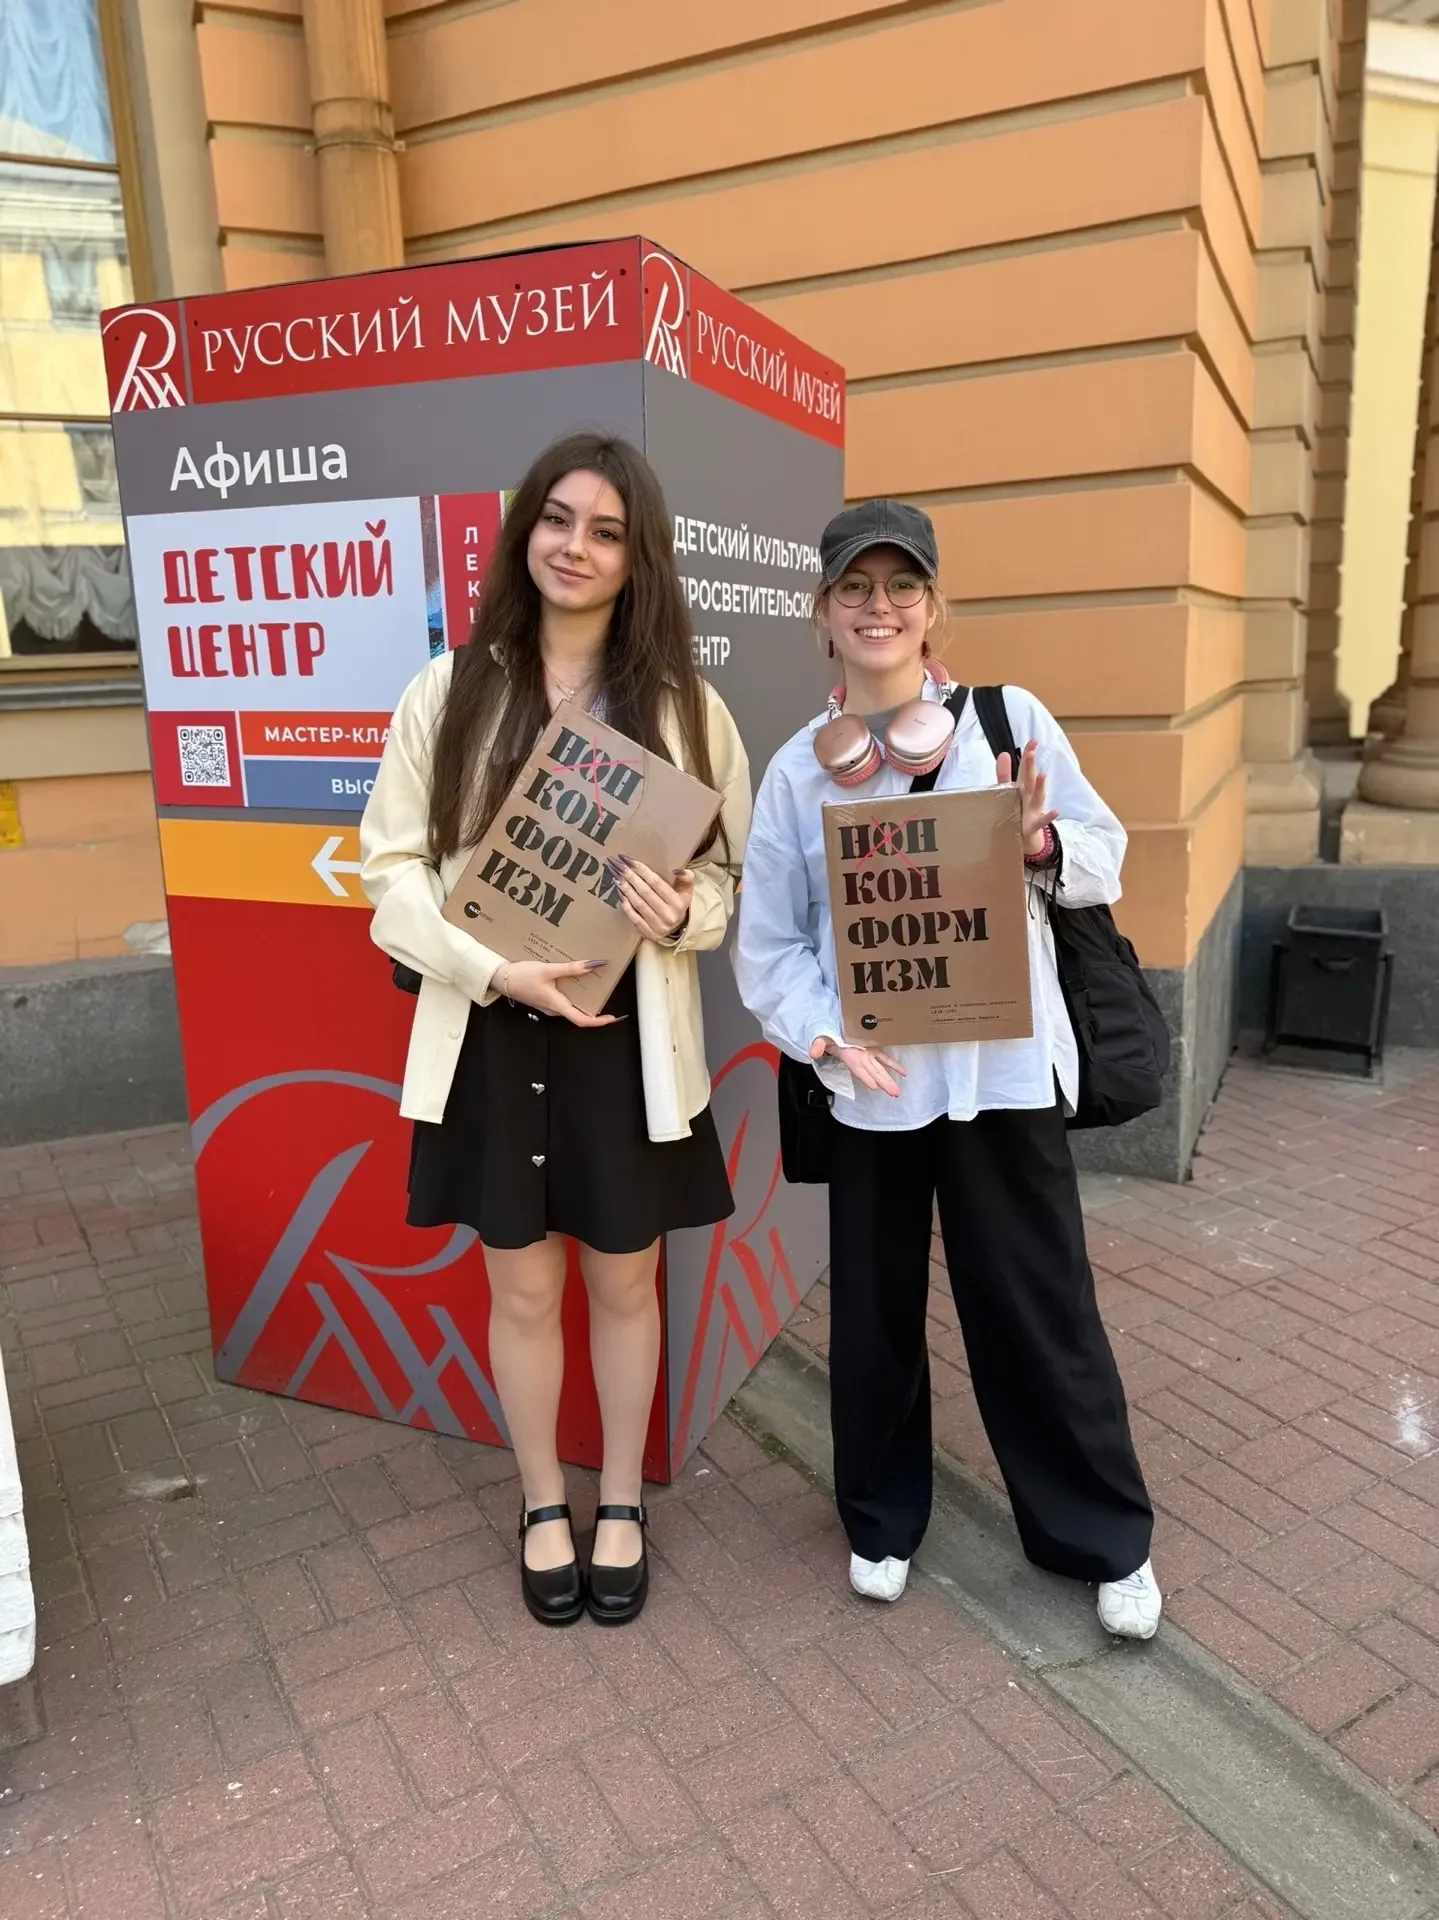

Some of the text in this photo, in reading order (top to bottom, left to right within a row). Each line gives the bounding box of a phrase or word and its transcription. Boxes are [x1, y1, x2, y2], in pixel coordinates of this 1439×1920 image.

[201, 270, 619, 374] РУССКИЙ МУЗЕЙ
[696, 309, 842, 425] РУССКИЙ МУЗЕЙ
[170, 441, 348, 499] Афиша
[162, 519, 394, 604] ДЕТСКИЙ
[673, 515, 750, 562] ДЕТСКИЙ
[167, 622, 325, 678] ЦЕНТР
[690, 635, 730, 666] ЕНТР
[547, 726, 644, 806] НОН
[523, 768, 621, 846] КОН
[505, 815, 622, 910] ФОРМ
[838, 818, 940, 860] НОН
[476, 848, 575, 928] ИЗМ
[842, 865, 942, 906] КОН
[847, 908, 989, 949] ФОРМ
[851, 956, 951, 994] ИЗМ
